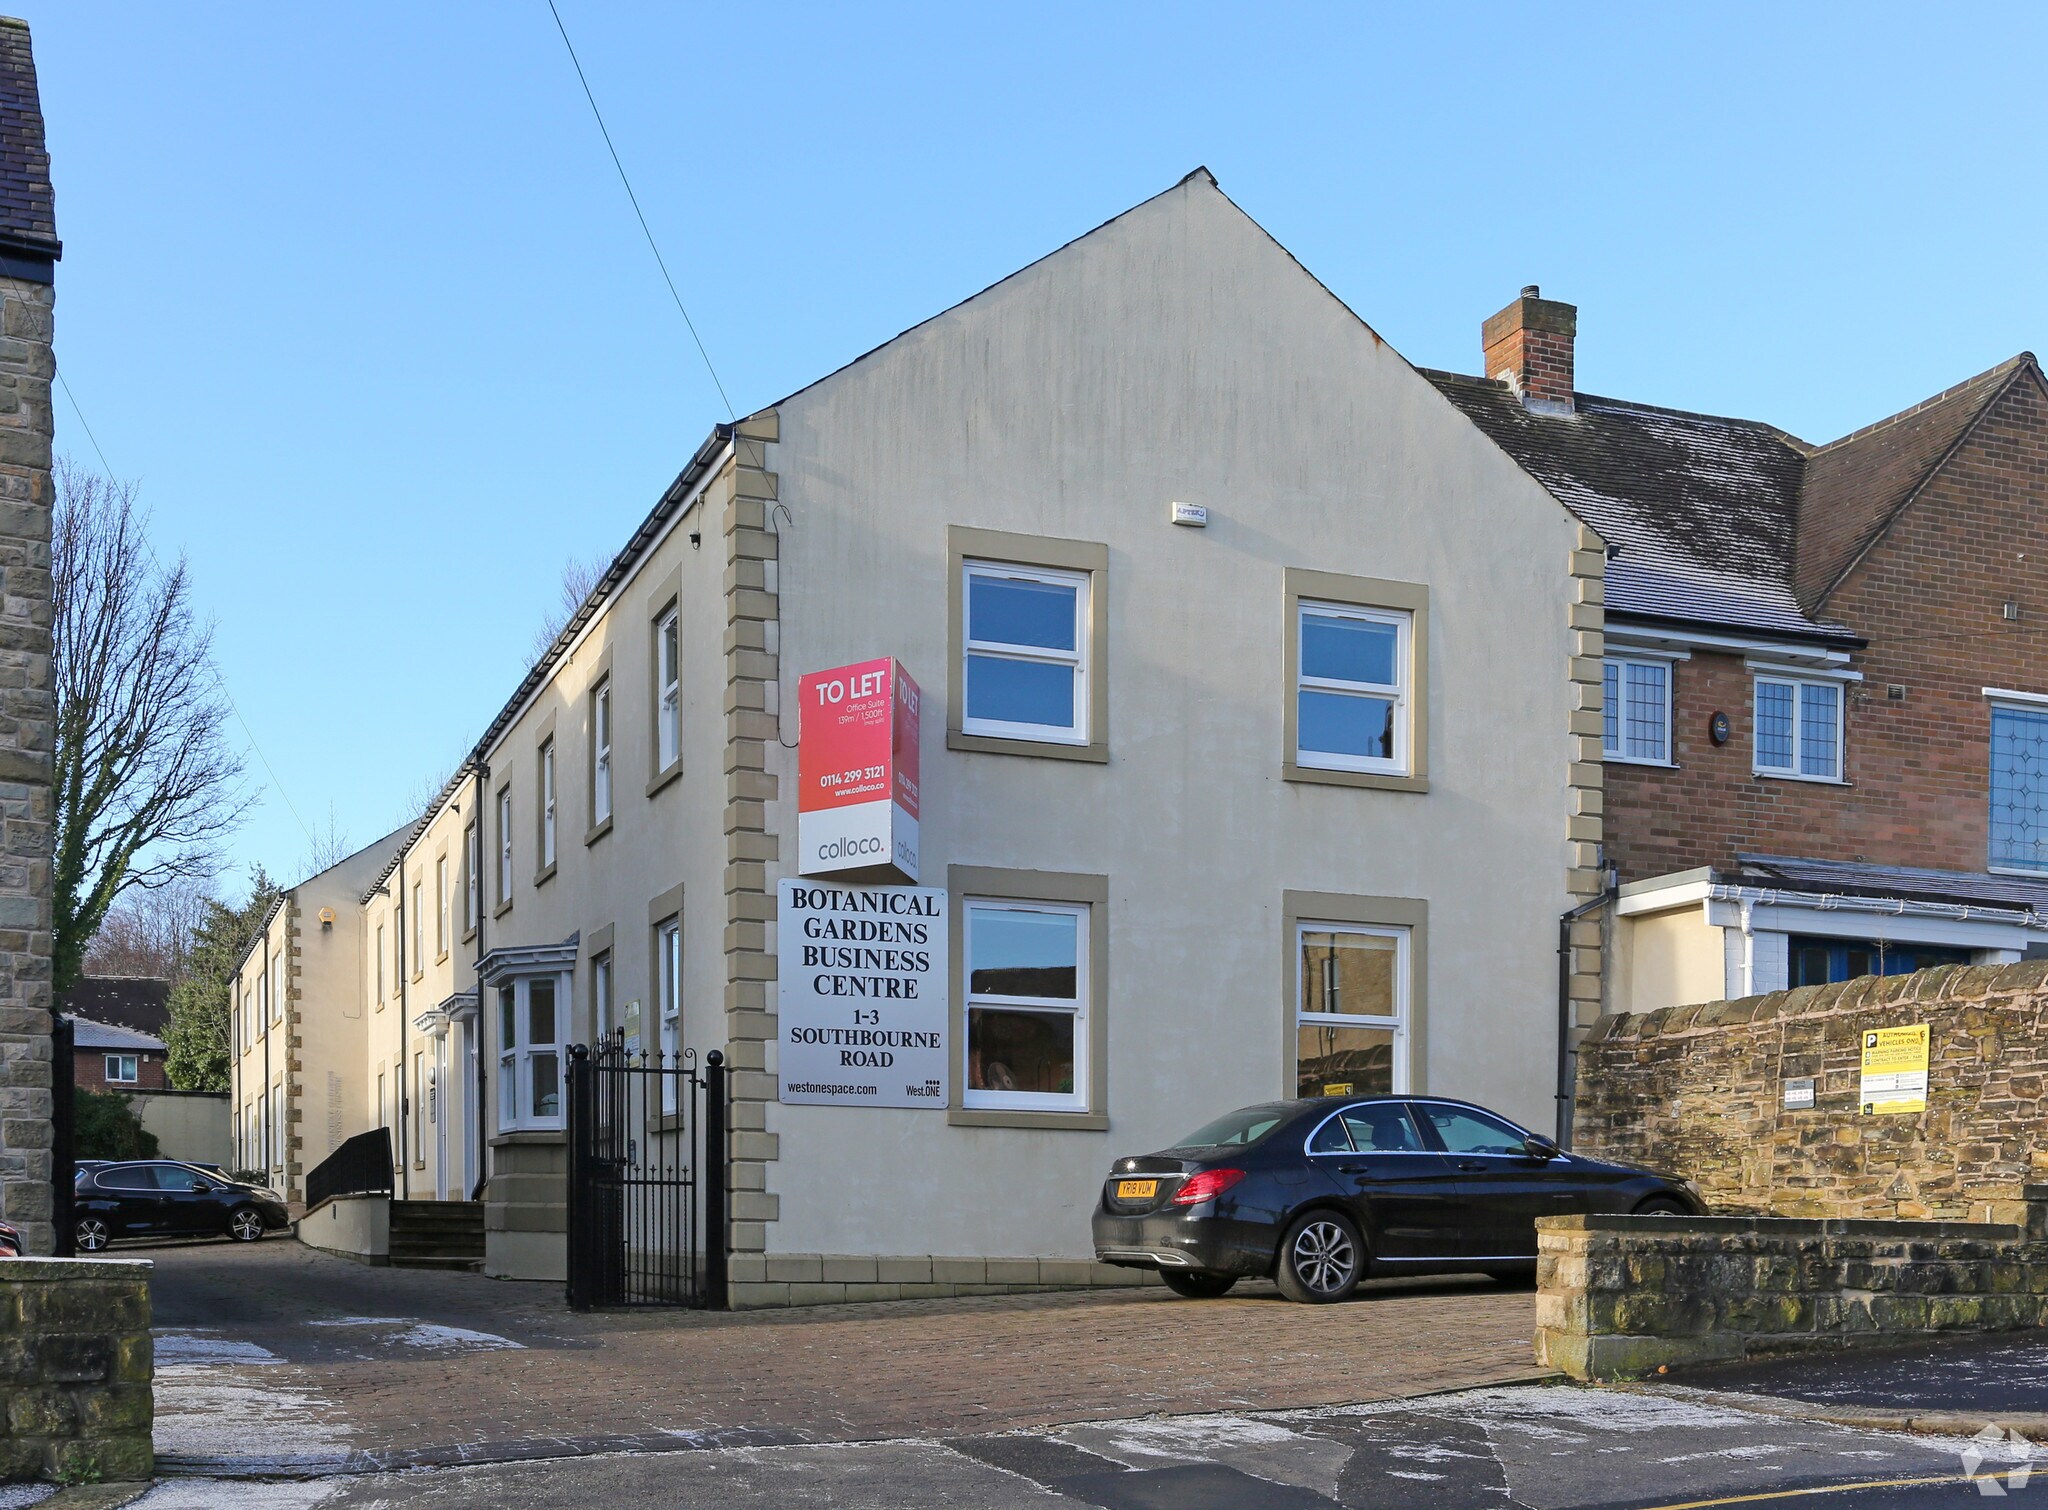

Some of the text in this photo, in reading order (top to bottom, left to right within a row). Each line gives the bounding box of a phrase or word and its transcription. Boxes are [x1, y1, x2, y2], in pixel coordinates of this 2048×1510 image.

[816, 671, 885, 705] TO LET
[899, 676, 907, 704] TO
[908, 687, 918, 716] LET
[846, 699, 885, 713] Office Suite
[820, 765, 885, 788] 0114 299 3121
[835, 783, 885, 796] www.colloco.co
[819, 837, 885, 860] colloco.
[791, 887, 940, 917] BOTANICAL
[803, 917, 928, 944] GARDENS
[802, 945, 930, 972] BUSINESS
[813, 974, 919, 999] CENTRE
[853, 1009, 880, 1025] 1-3
[791, 1027, 941, 1048] SOUTHBOURNE
[1879, 1039, 1905, 1047] VEHICLES
[840, 1050, 894, 1067] ROAD
[788, 1082, 877, 1096] westonespace.com
[906, 1085, 941, 1097] West.ONE
[1122, 1182, 1137, 1195] YR18
